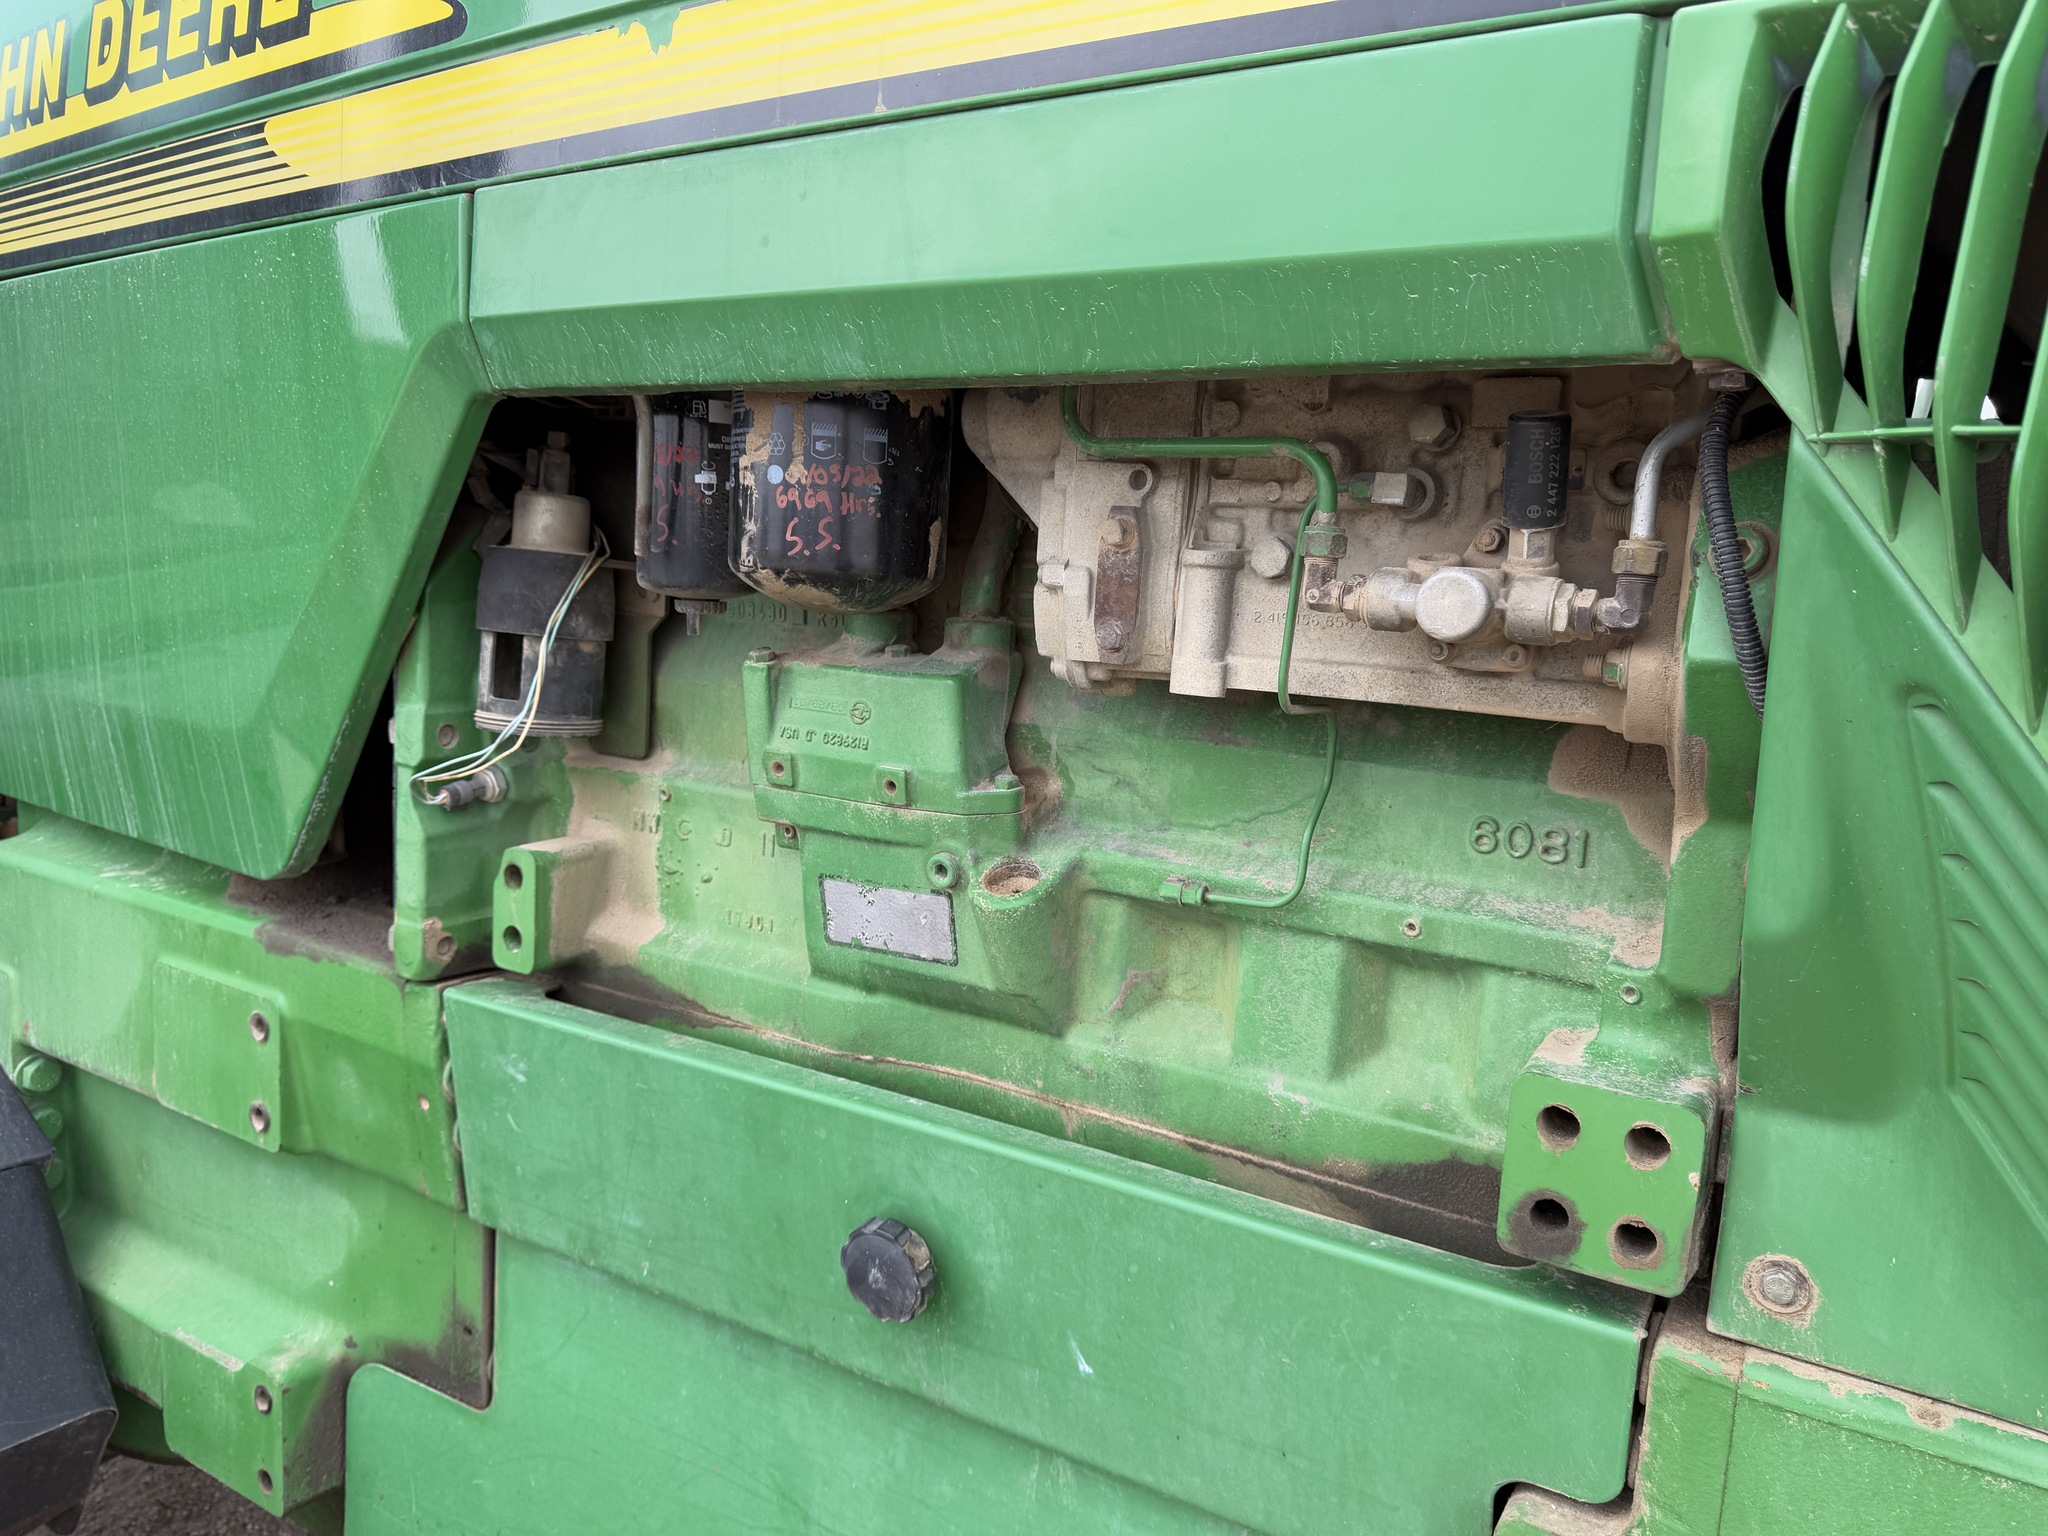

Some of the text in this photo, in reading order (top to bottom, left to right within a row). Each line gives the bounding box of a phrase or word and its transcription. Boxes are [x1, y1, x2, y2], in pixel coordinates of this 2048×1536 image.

[1527, 428, 1545, 484] BOSCH
[1546, 426, 1562, 518] 2 447 222 126
[1468, 814, 1590, 869] 6081
